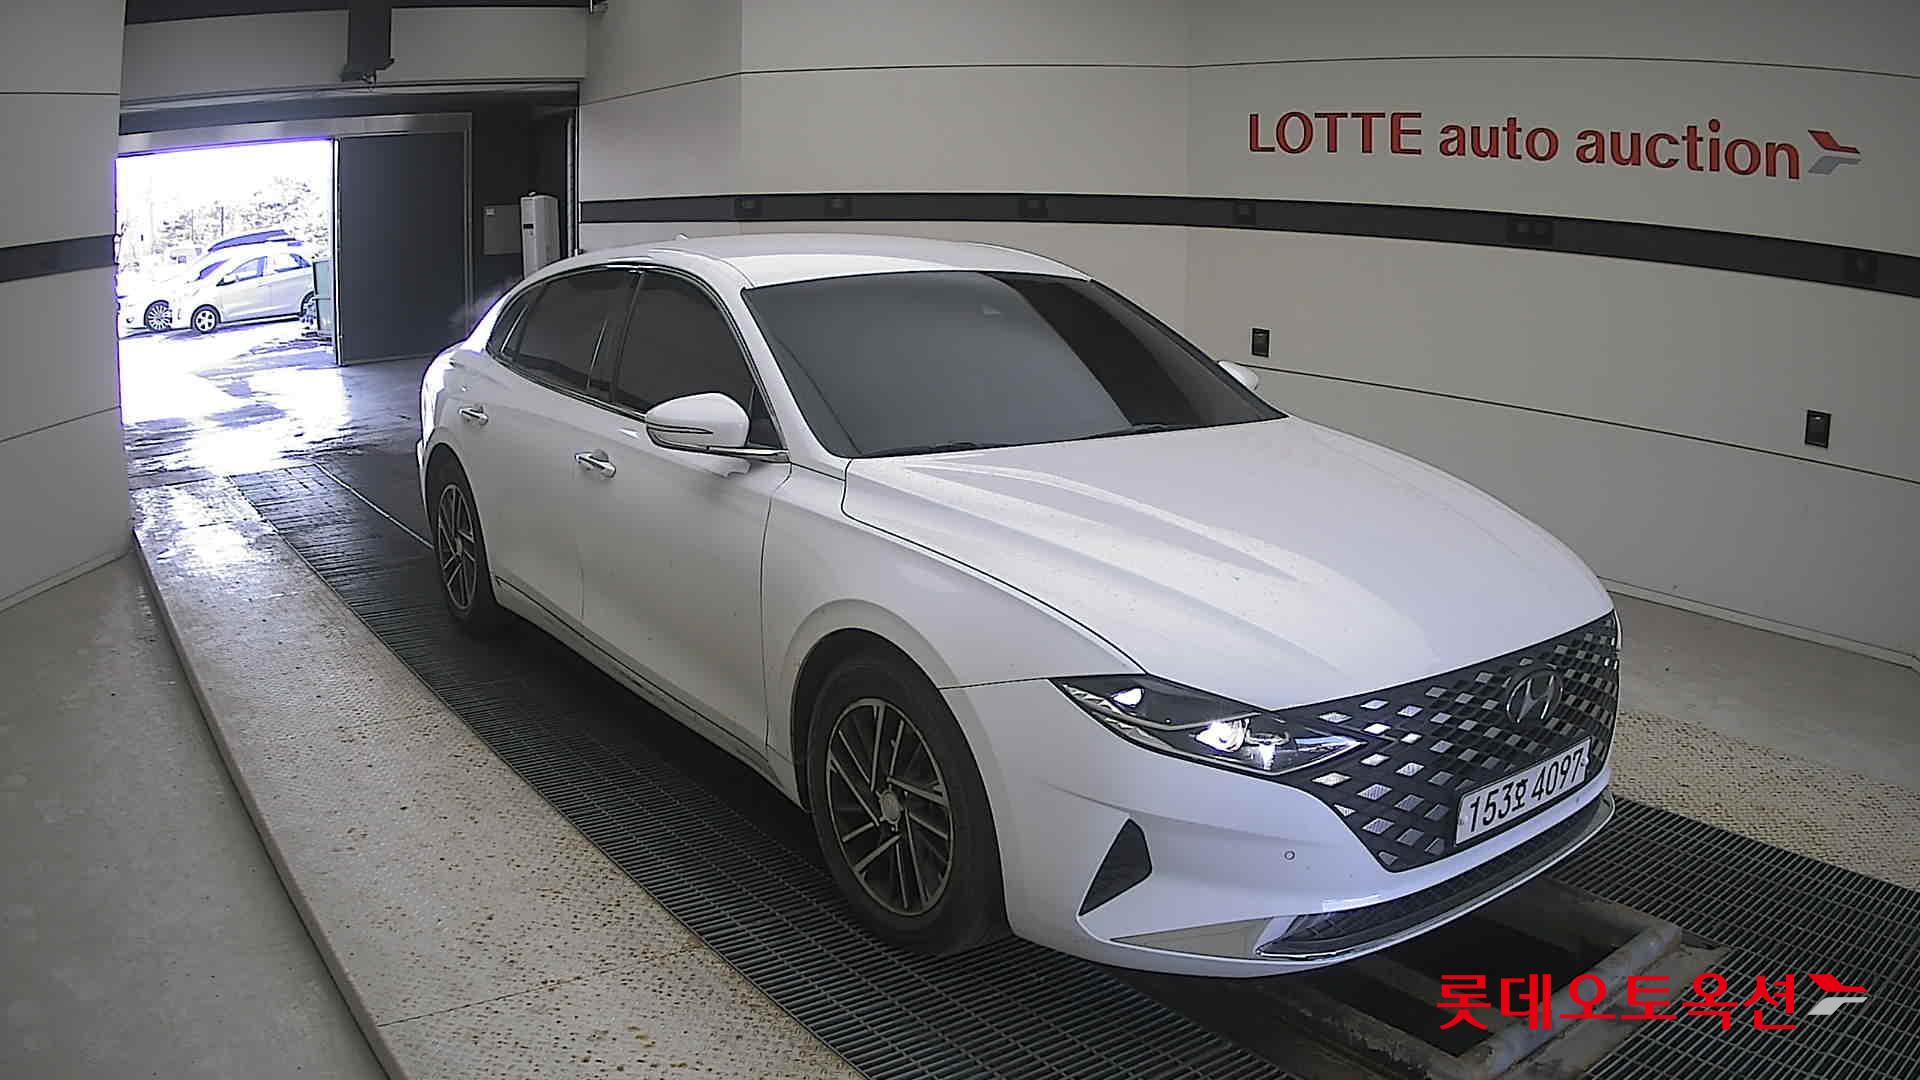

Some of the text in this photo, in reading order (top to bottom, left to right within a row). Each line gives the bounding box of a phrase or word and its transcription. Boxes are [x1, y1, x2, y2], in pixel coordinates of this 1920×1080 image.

[1248, 111, 1801, 180] LOTTE auto auction
[1531, 748, 1584, 801] 4097
